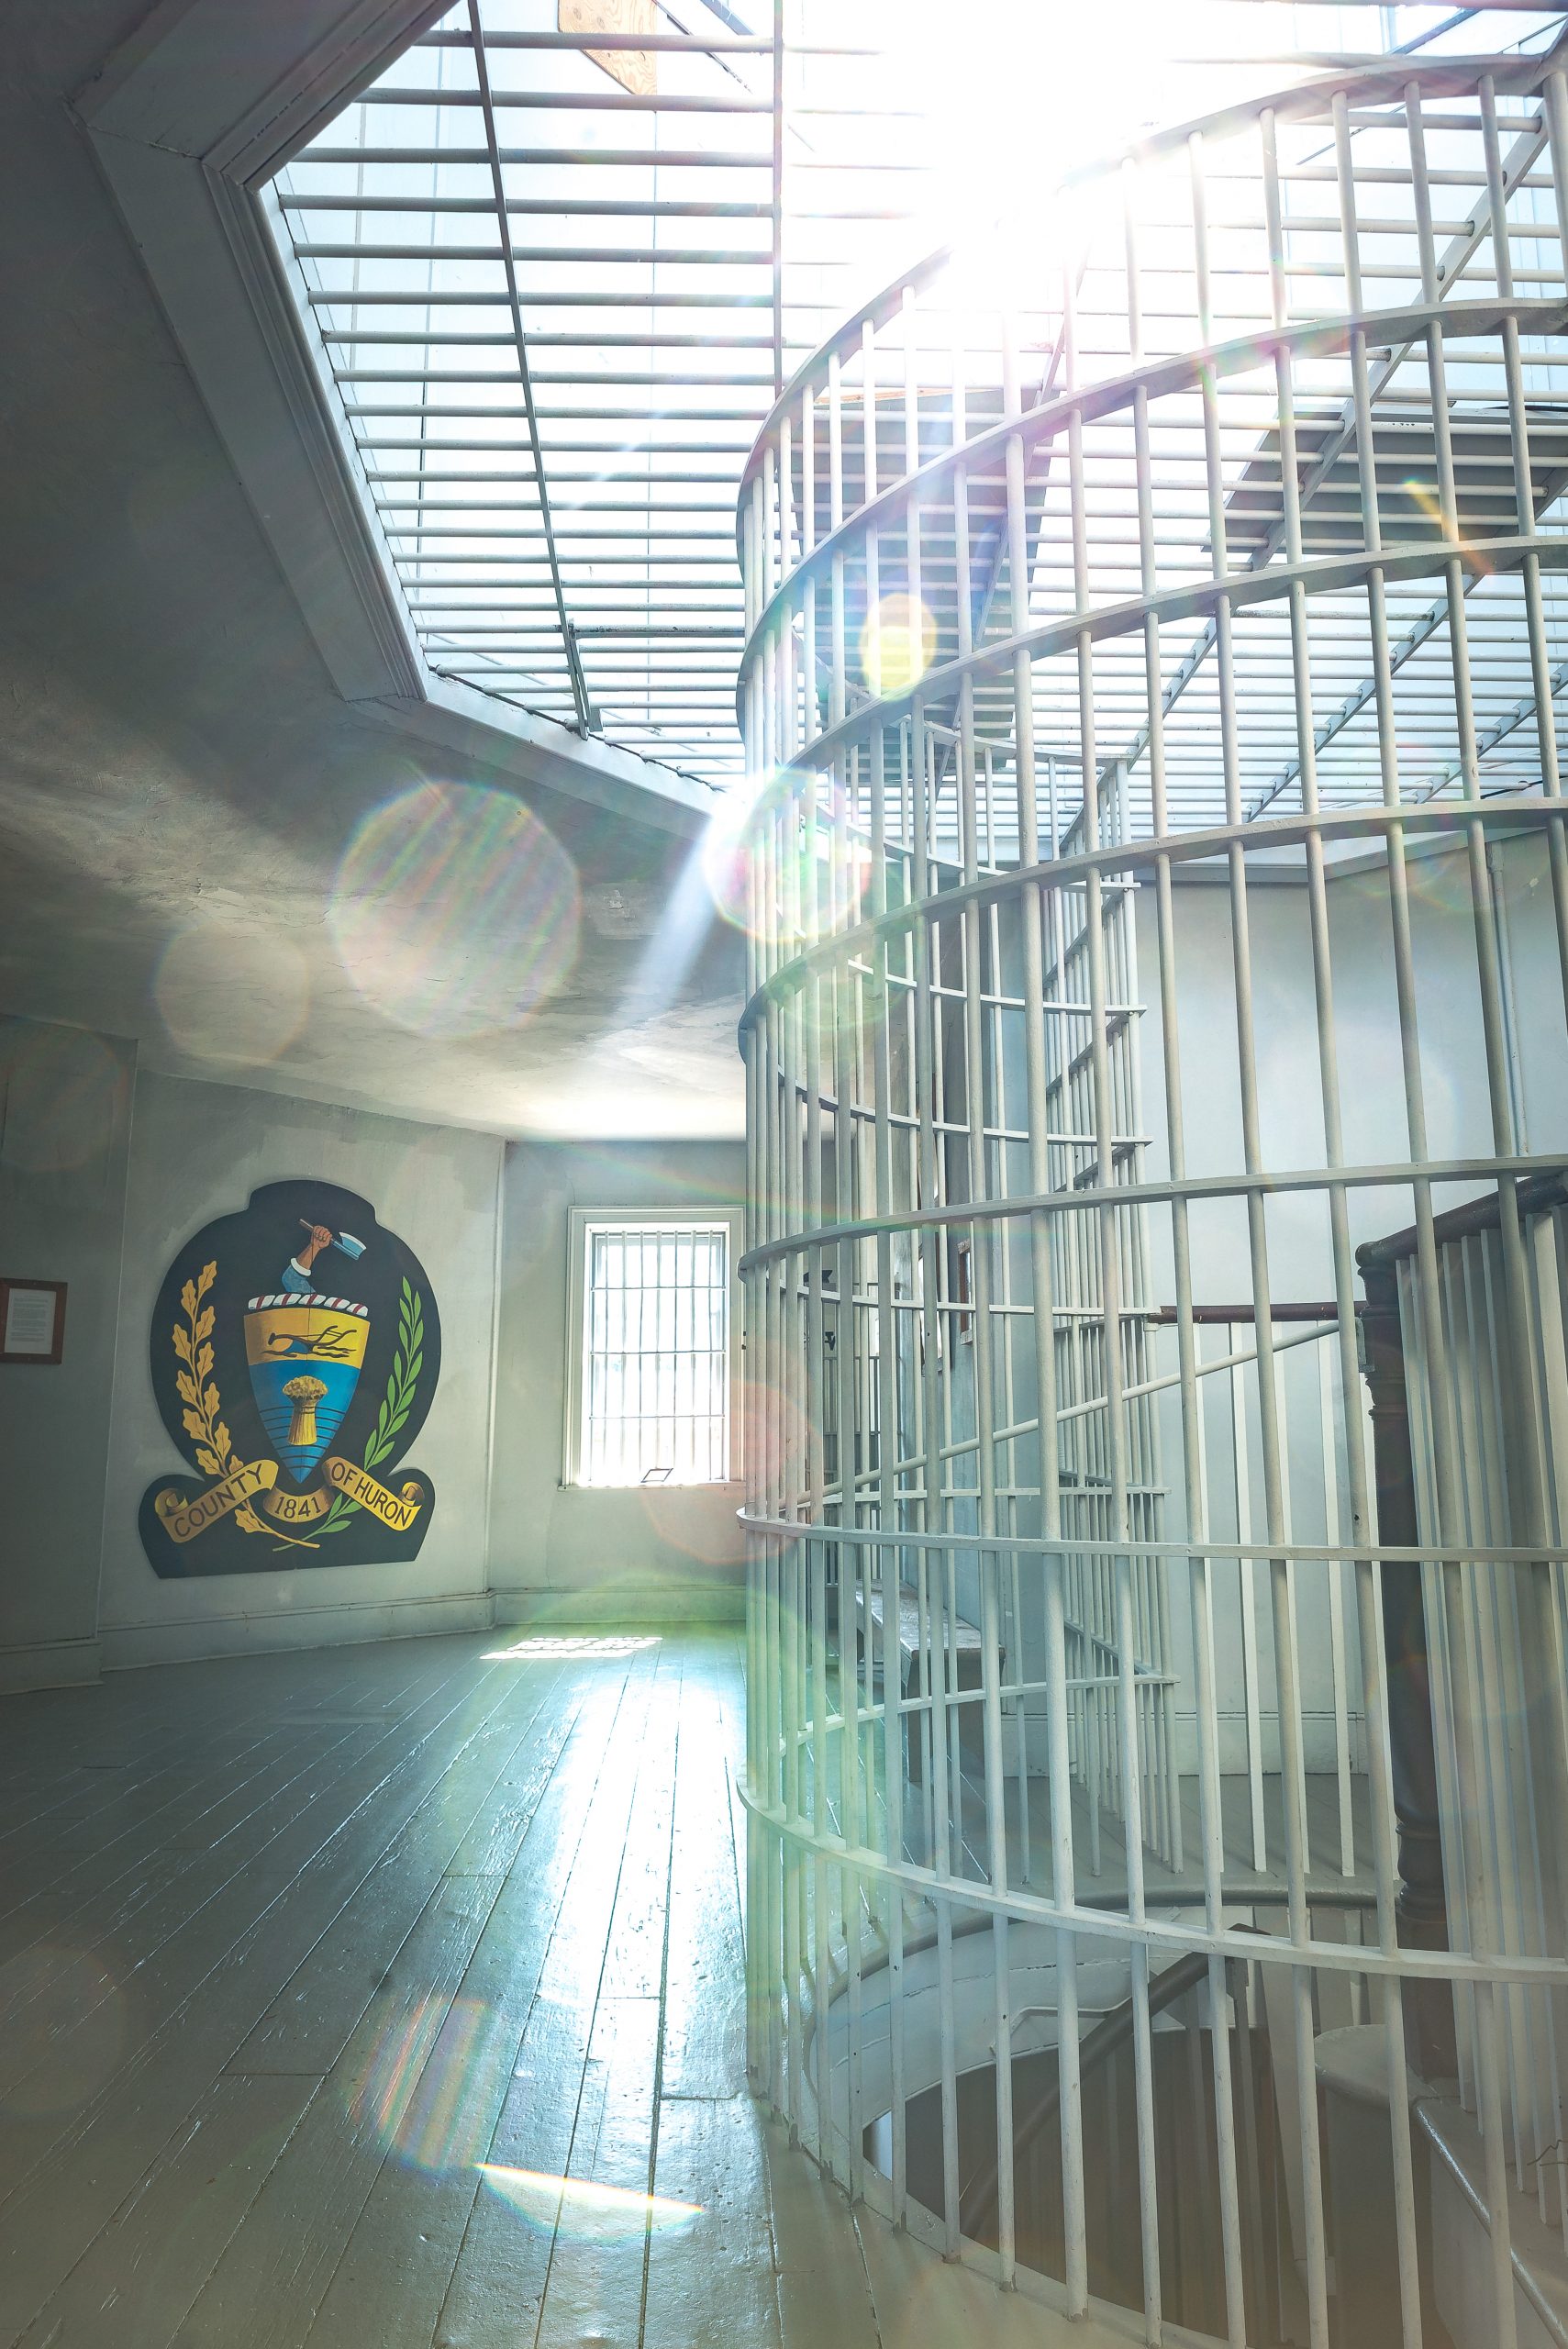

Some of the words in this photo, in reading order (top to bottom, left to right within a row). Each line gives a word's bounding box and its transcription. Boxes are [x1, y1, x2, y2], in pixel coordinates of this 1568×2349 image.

[174, 1463, 262, 1538] COUNTY
[330, 1462, 356, 1485] OF
[353, 1476, 411, 1528] HURON
[273, 1497, 322, 1520] 1841
